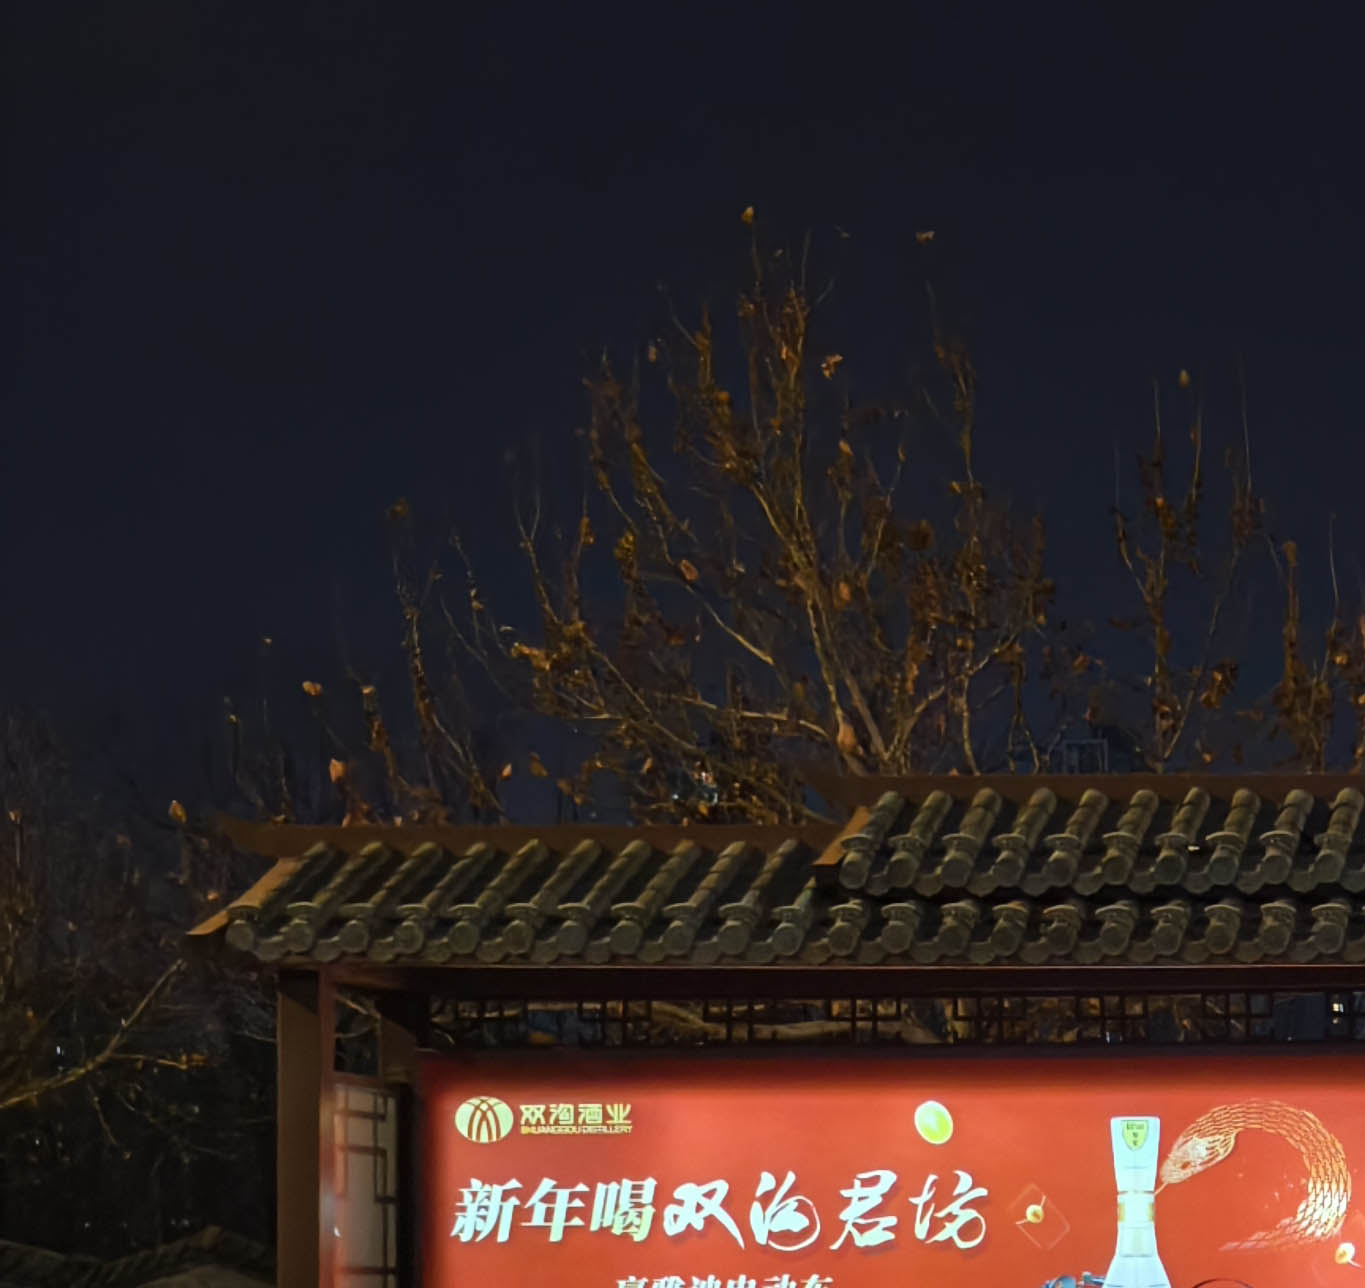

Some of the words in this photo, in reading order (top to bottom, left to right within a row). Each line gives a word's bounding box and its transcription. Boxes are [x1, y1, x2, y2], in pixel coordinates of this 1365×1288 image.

[520, 1103, 632, 1125] 双沟酒业
[450, 1170, 988, 1251] 新年喝双沟君坊
